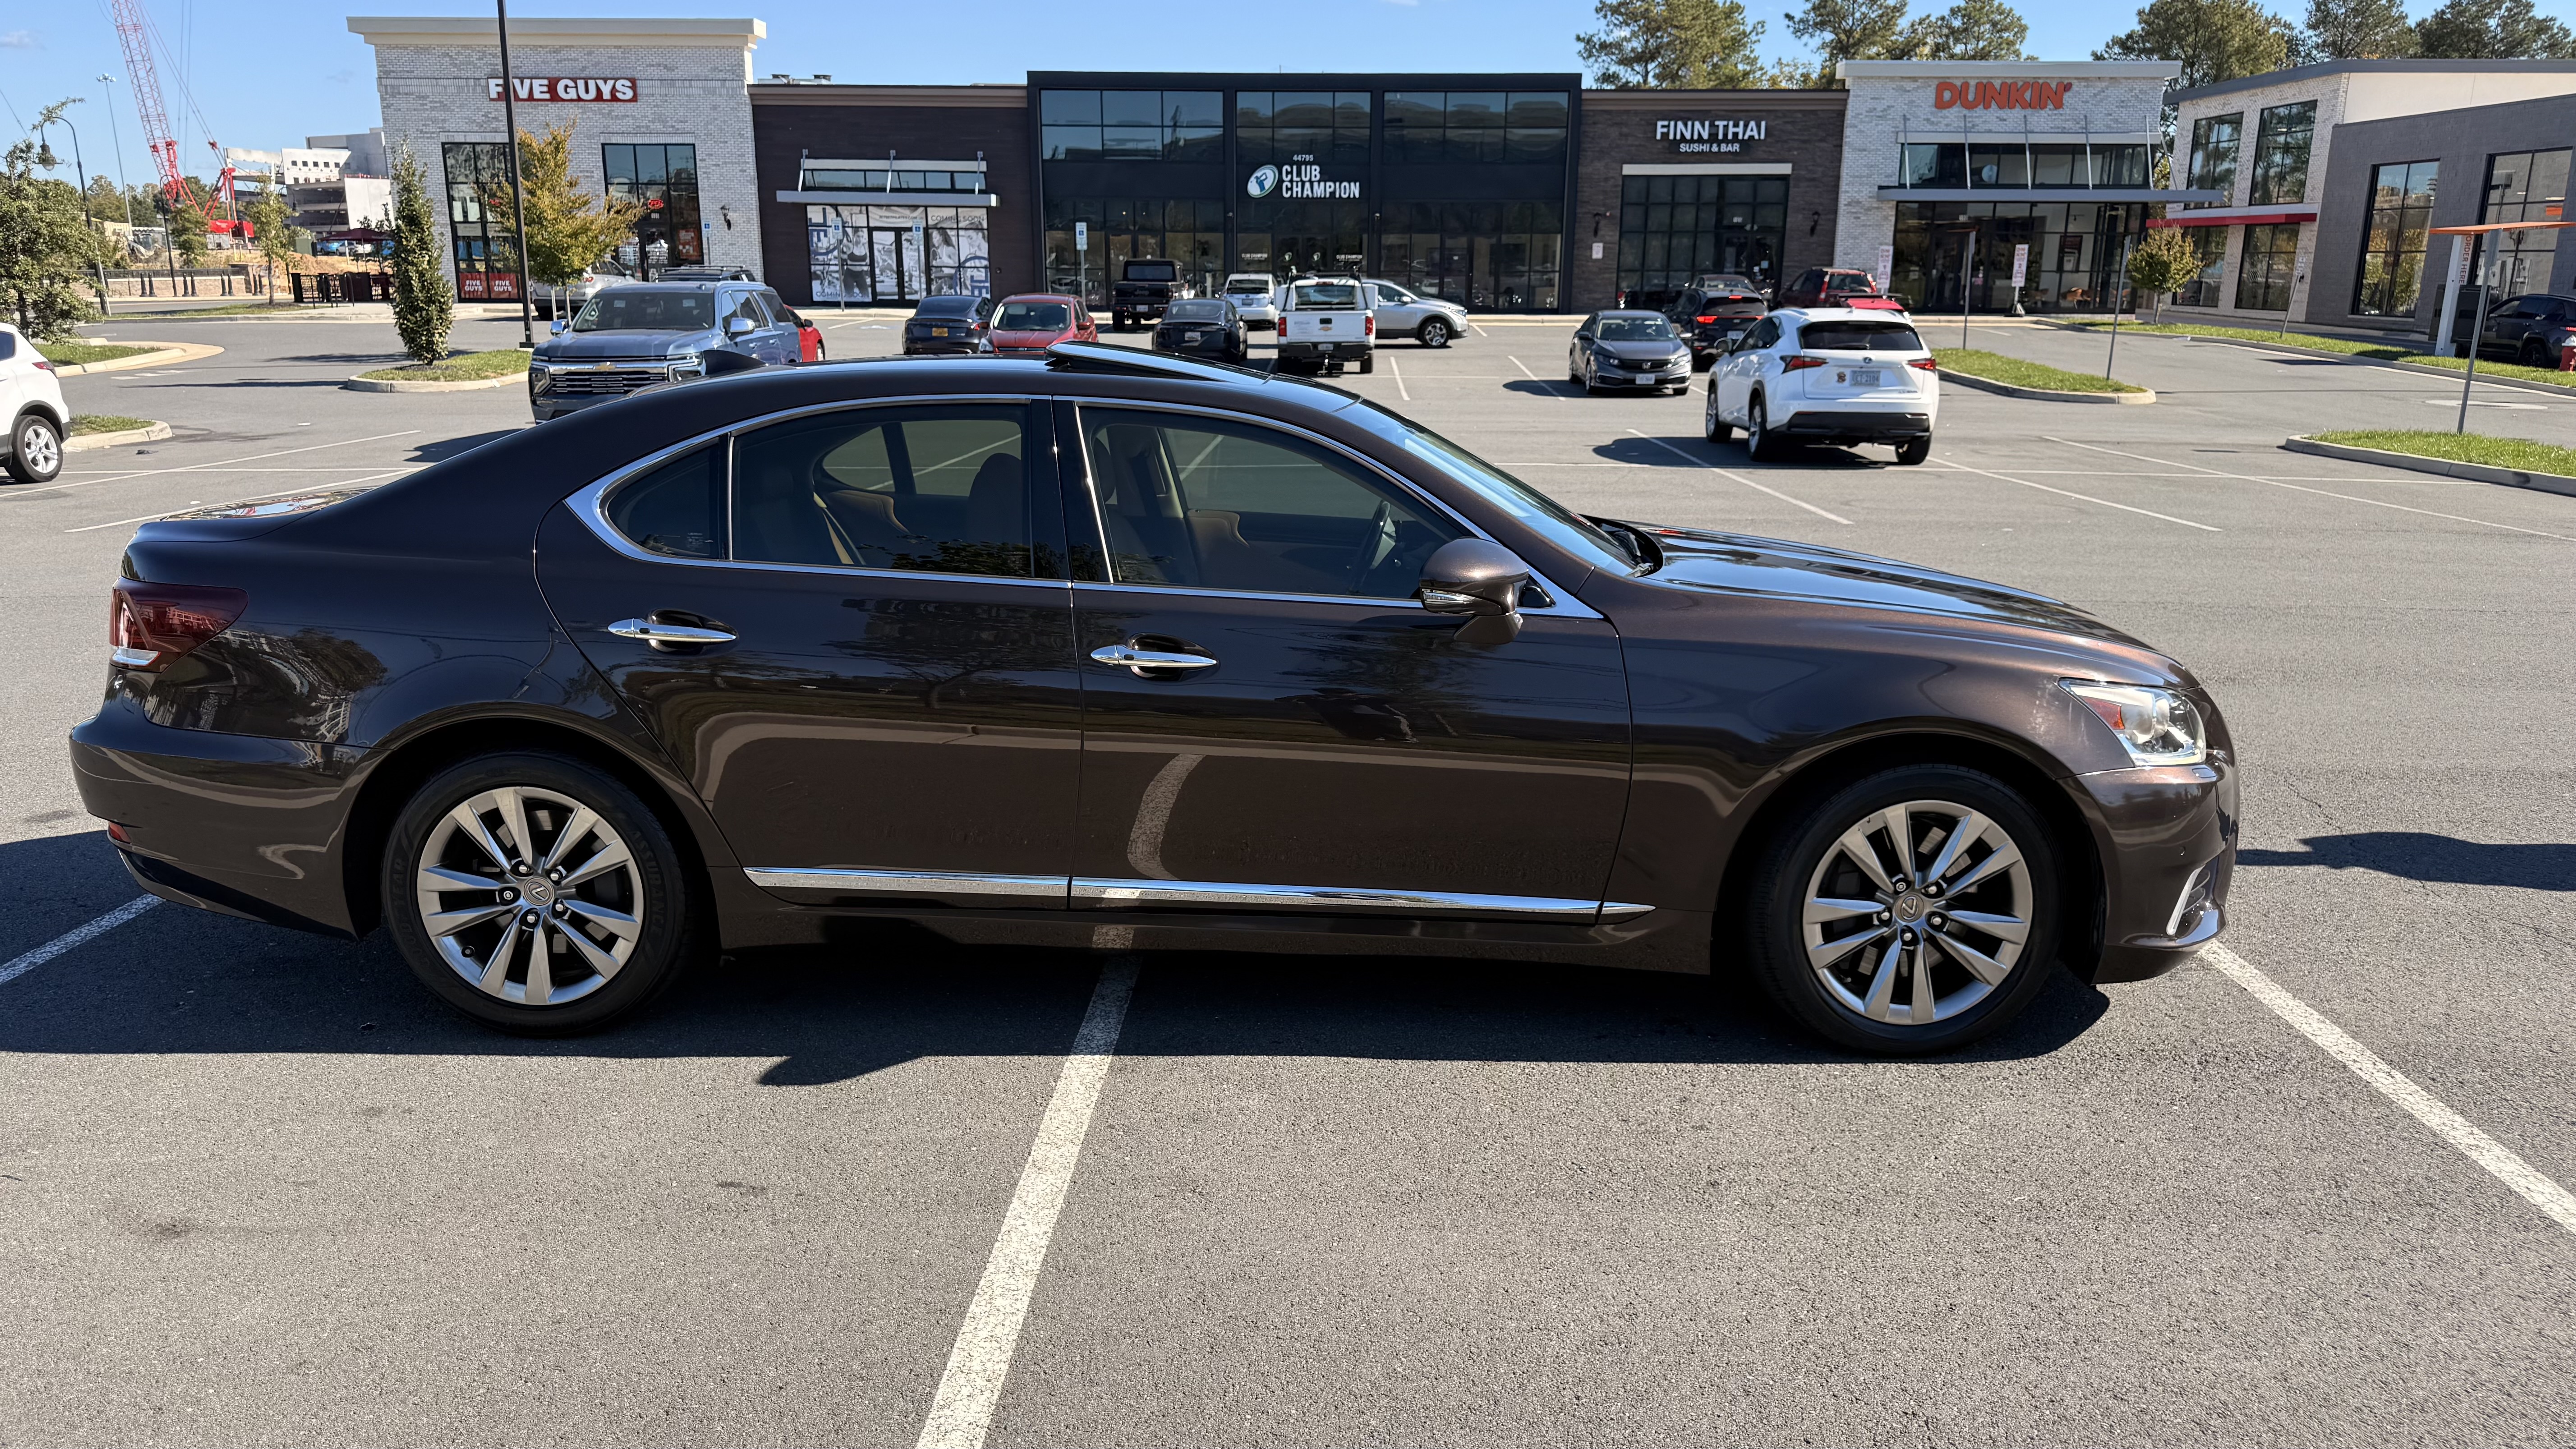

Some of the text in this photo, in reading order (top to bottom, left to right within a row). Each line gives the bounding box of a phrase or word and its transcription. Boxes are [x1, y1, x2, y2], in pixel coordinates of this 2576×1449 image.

[488, 78, 634, 100] FVE GUYS
[1935, 81, 2073, 110] DUNKIN'
[1656, 120, 1766, 140] FINN THAI
[1679, 143, 1740, 152] SUSHI & BAR
[1282, 165, 1320, 181] CLUB
[1282, 181, 1360, 198] CHAMPION
[2459, 235, 2472, 284] ORDER HERE
[392, 857, 405, 906] YEAR
